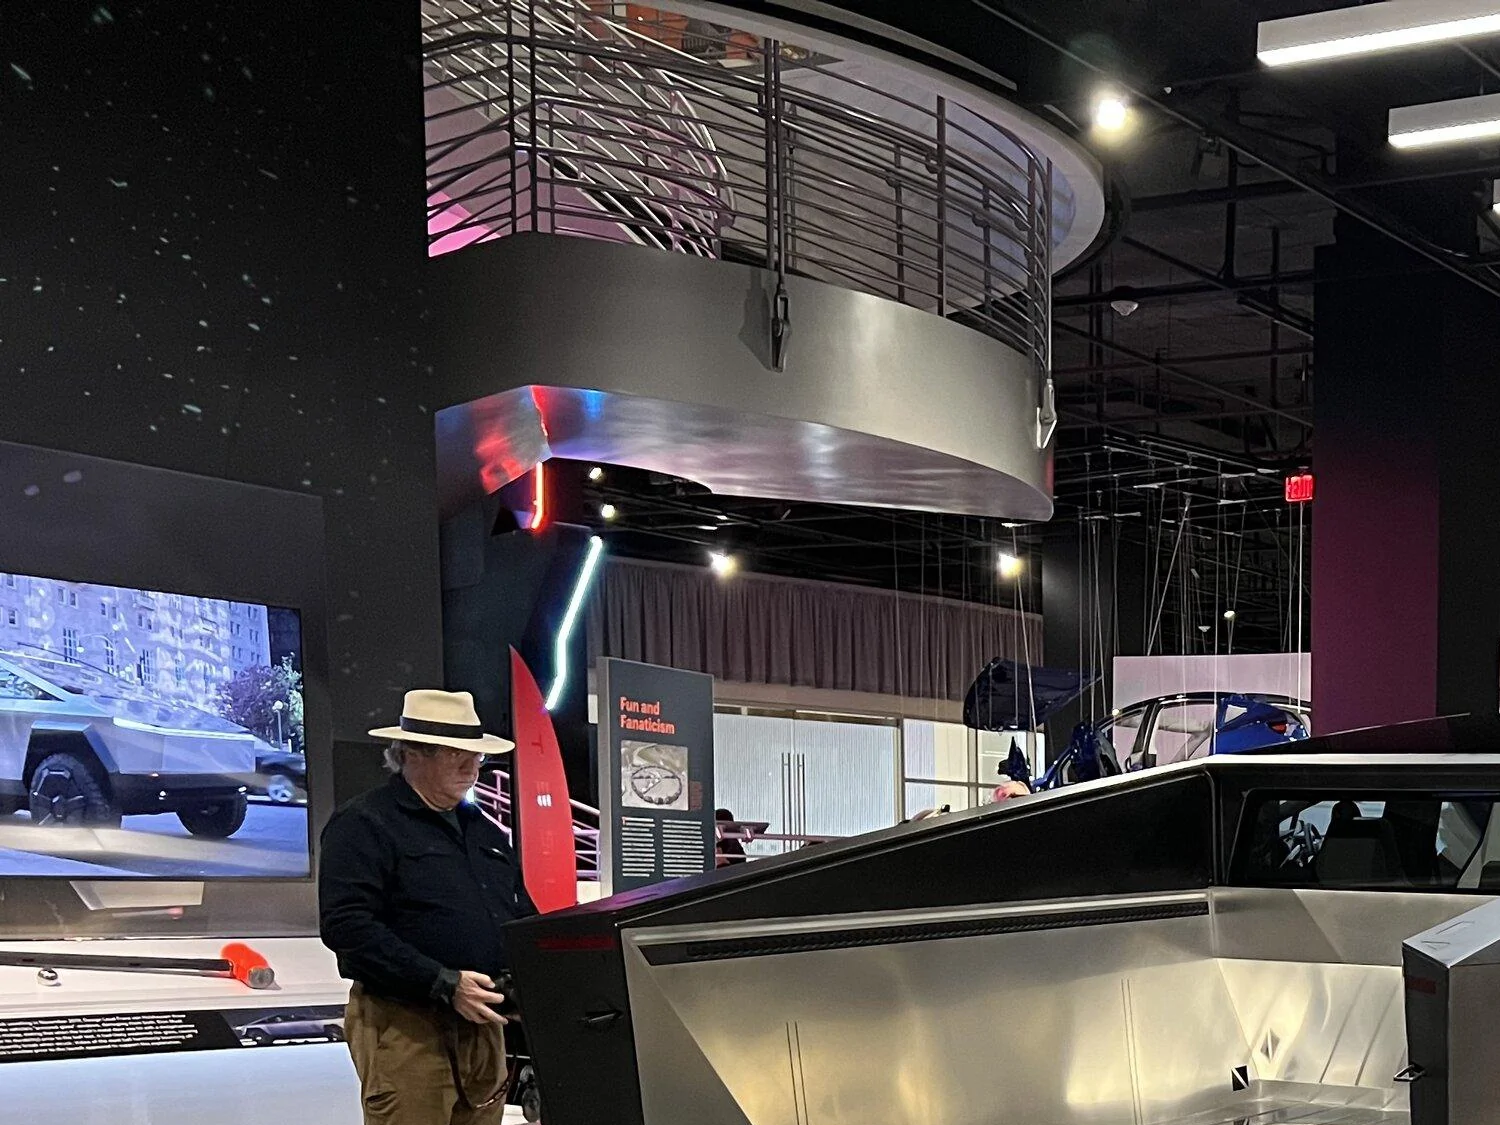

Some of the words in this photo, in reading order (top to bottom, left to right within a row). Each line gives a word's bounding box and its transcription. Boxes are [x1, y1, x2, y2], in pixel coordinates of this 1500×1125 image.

[620, 696, 639, 712] Fun
[641, 701, 660, 715] and
[620, 714, 675, 735] Fanaticism
